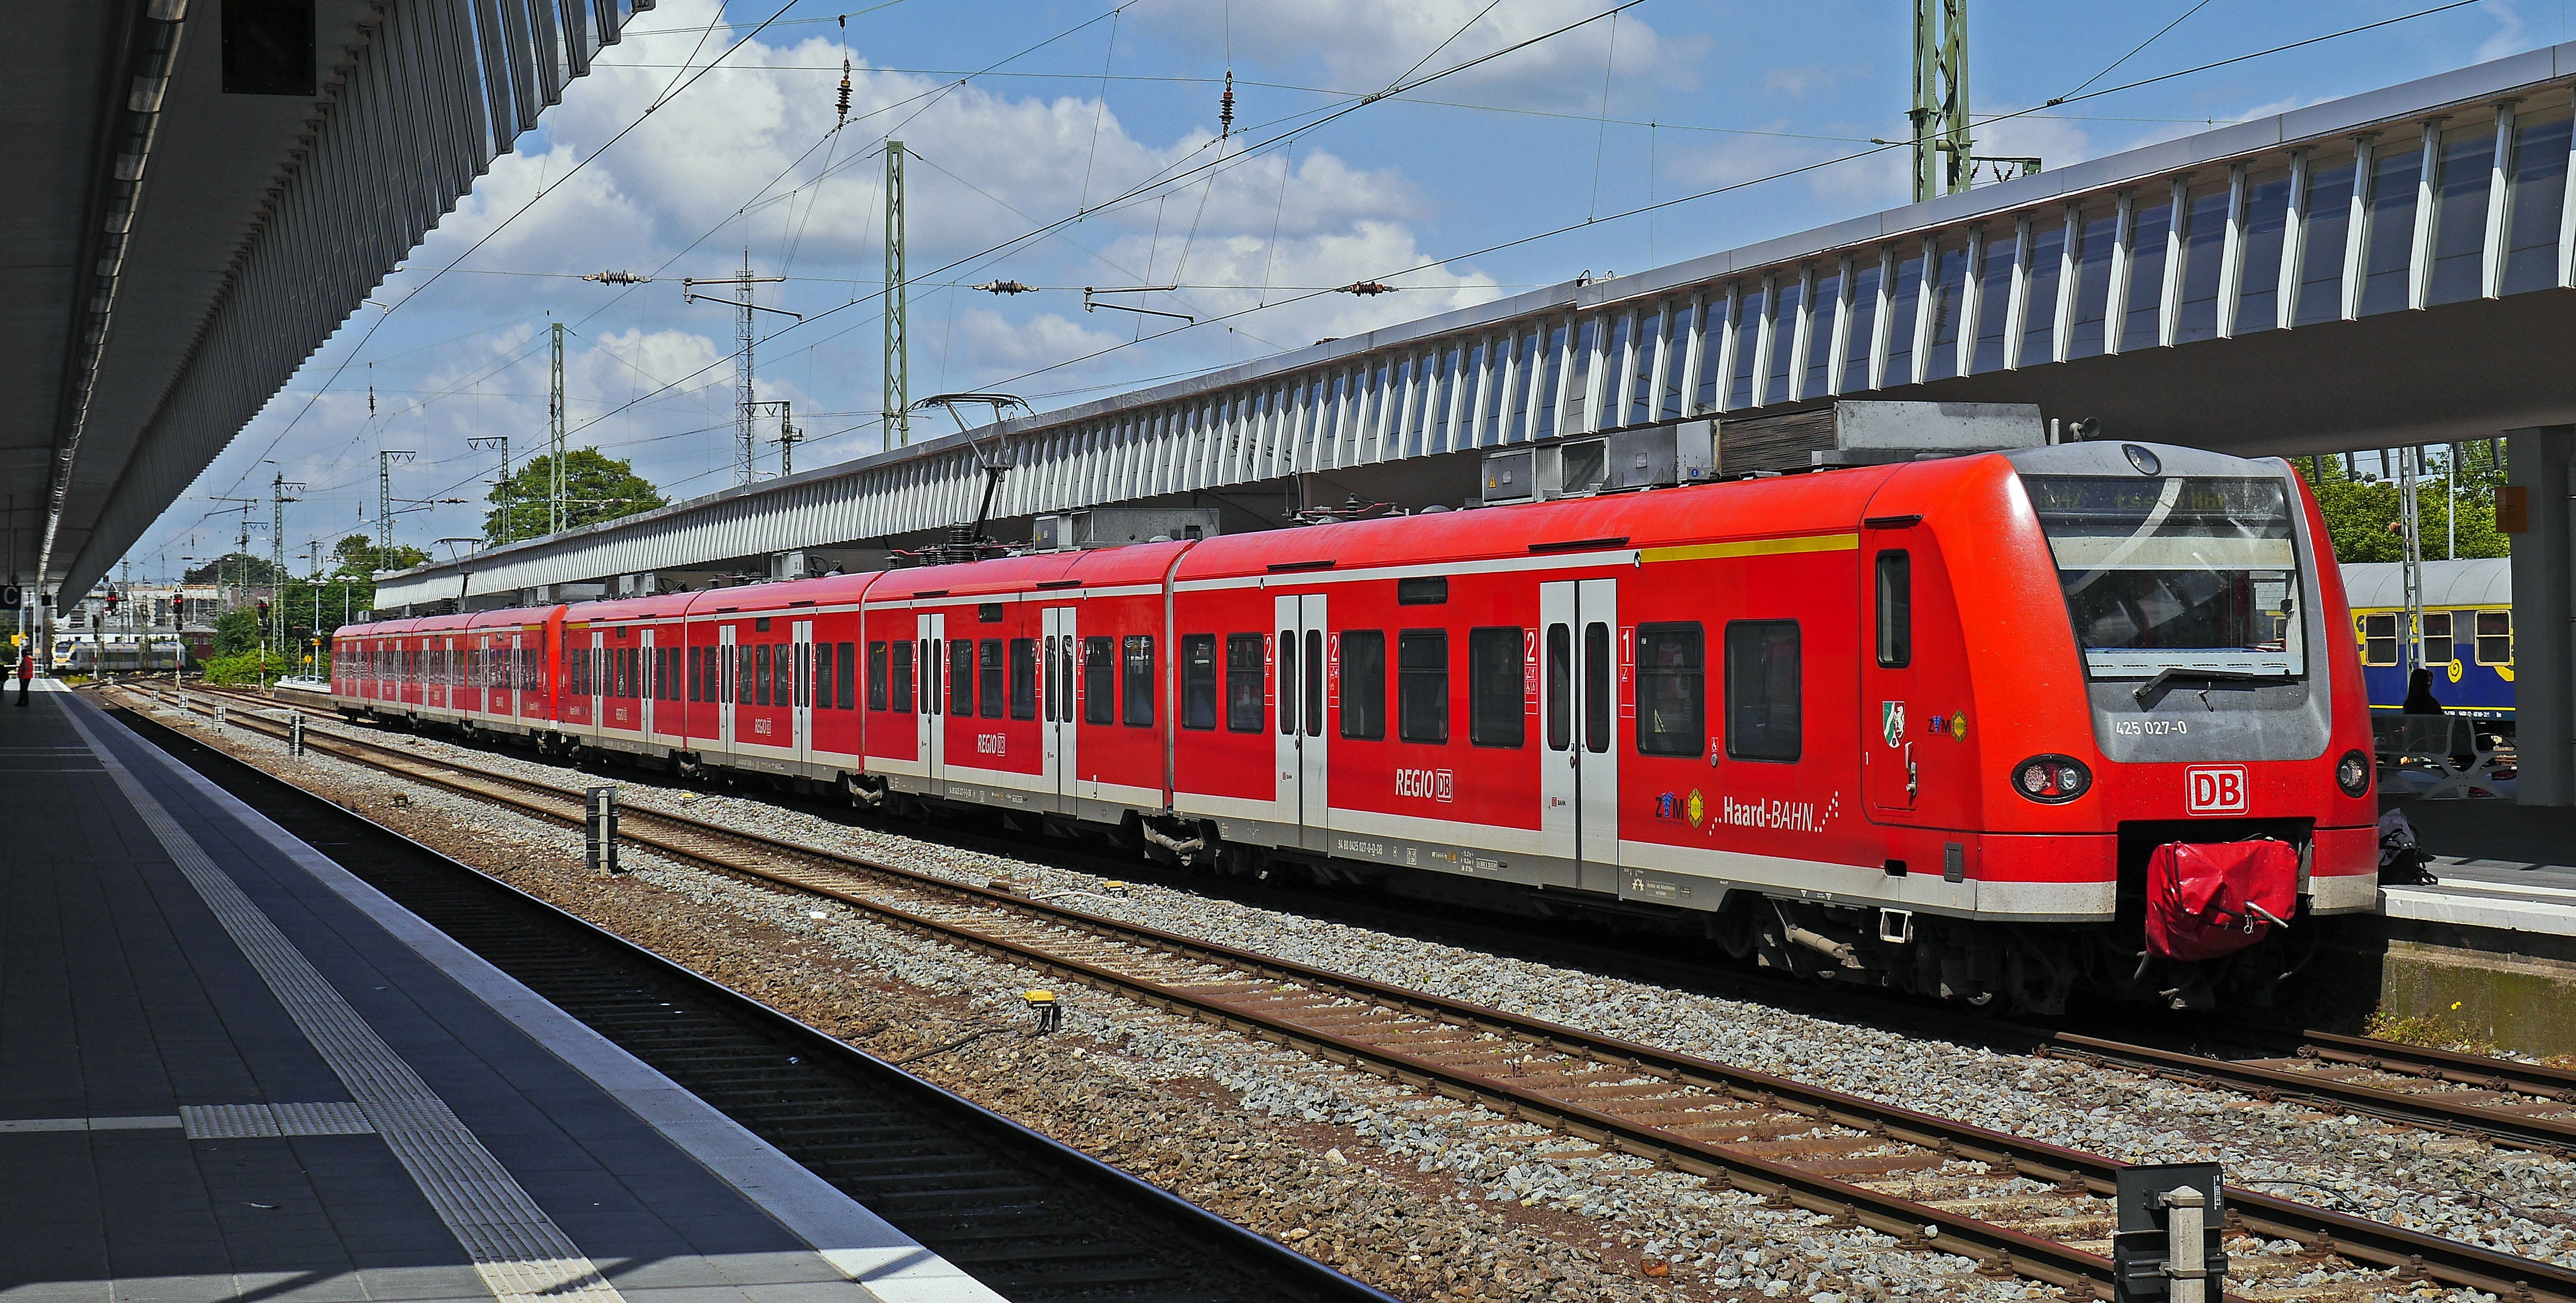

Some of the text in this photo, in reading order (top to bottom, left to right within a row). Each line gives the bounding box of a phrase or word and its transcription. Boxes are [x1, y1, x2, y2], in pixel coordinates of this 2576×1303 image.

[3, 586, 18, 605] C
[912, 643, 917, 662] 2
[945, 644, 950, 662] 2
[1036, 642, 1041, 663] 2
[1078, 641, 1084, 663] 2
[1265, 636, 1272, 662] 2
[1331, 635, 1337, 662] 2
[1527, 631, 1535, 662] 2
[1623, 629, 1629, 662] 1
[152, 691, 158, 700] H
[180, 696, 187, 706] H
[216, 708, 224, 720] H
[2116, 719, 2188, 735] 425 027-0
[977, 734, 1005, 755] REGIO DB
[1395, 768, 1452, 799] REGIO DB
[2195, 772, 2242, 807] DB
[1723, 795, 1814, 832] Haard-BAHN
[1338, 839, 1343, 850] 94
